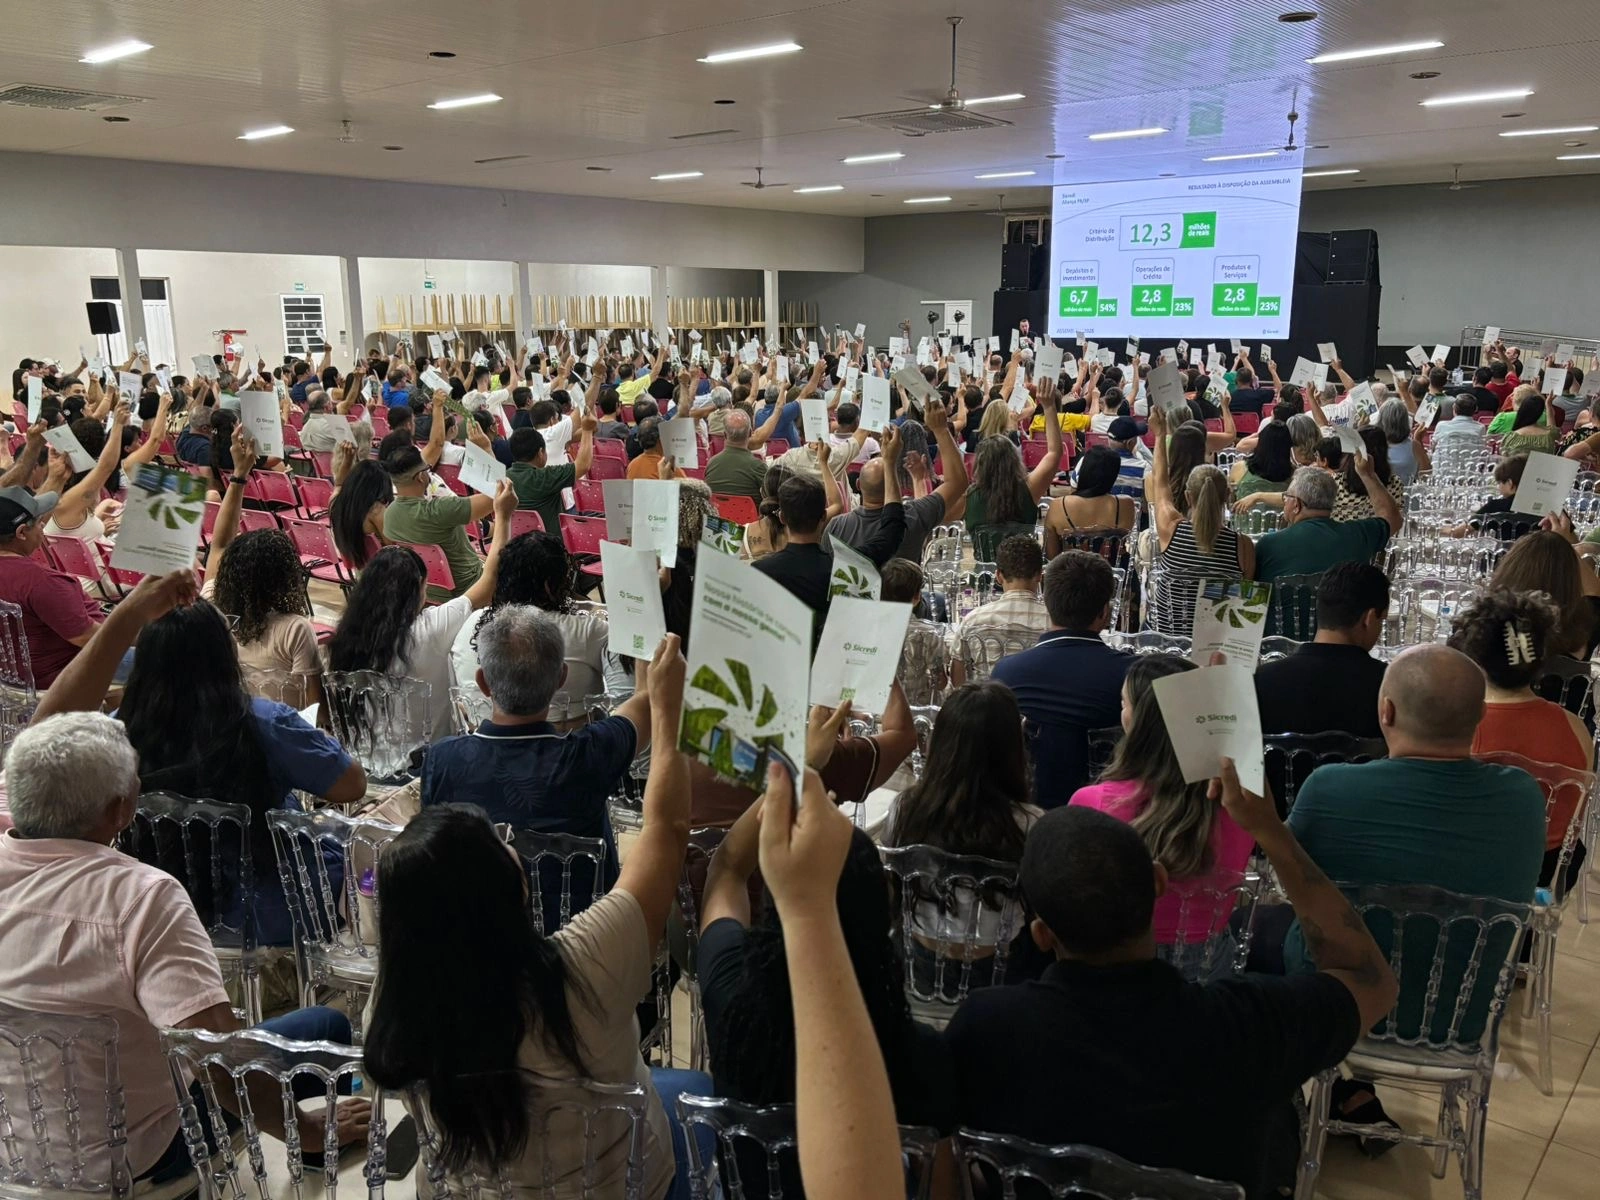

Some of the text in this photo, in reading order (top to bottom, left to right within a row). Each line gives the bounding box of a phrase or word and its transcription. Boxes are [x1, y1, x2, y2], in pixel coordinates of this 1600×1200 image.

[1130, 223, 1171, 246] 12,3
[1070, 290, 1088, 305] 6,7
[1142, 290, 1161, 304] 2,8
[1224, 288, 1245, 304] 2,8
[1175, 303, 1191, 311] 23%
[1260, 302, 1278, 311] 23%
[704, 582, 731, 600] Nossa
[733, 594, 764, 618] história
[703, 595, 723, 608] com
[732, 608, 758, 625] nossa
[852, 644, 878, 653] Sicredi
[1207, 713, 1237, 722] Sicredi
